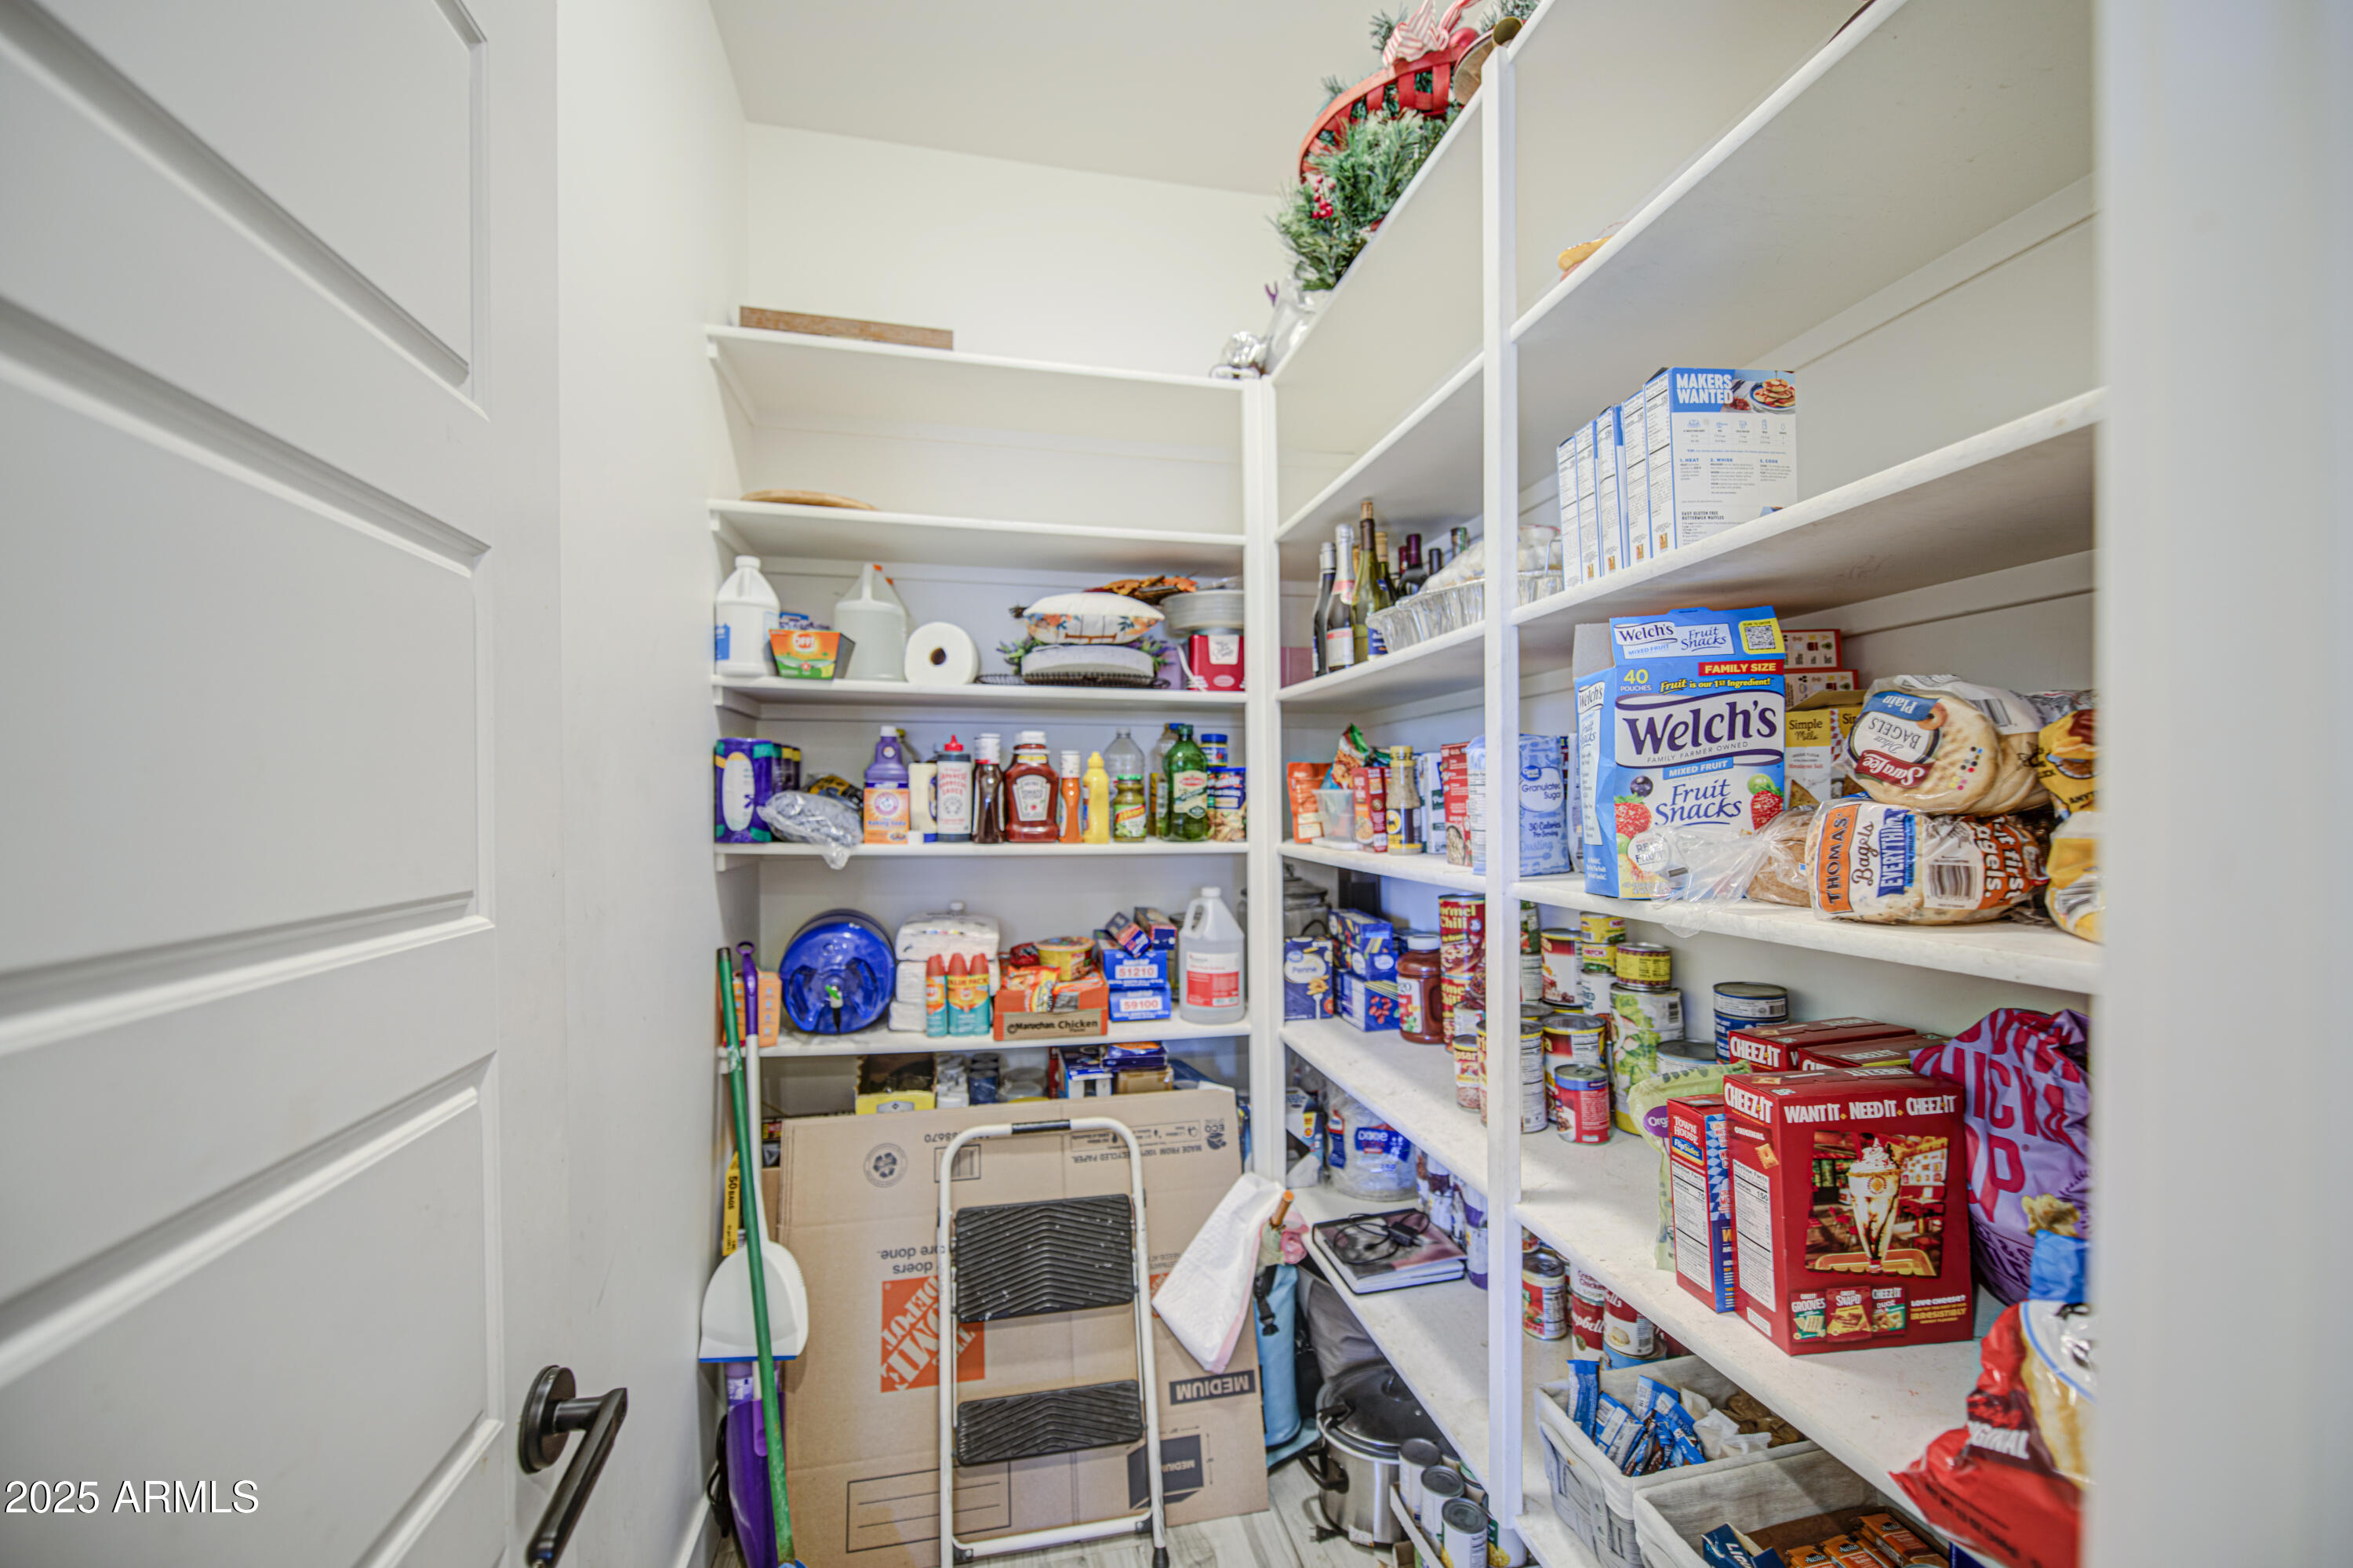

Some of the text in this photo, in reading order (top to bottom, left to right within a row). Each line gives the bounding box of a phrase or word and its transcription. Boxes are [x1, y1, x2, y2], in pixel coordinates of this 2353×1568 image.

[1676, 373, 1733, 389] MAKERS
[1677, 389, 1733, 405] WANTED
[1618, 624, 1674, 642] Welch's
[1688, 628, 1719, 640] Fruit
[1681, 634, 1726, 651] Snacks
[1705, 663, 1776, 673] FAMILY SIZE
[1624, 670, 1649, 684] 40
[1660, 678, 1688, 694] Fruit
[1727, 678, 1771, 689] Ingredient!
[1578, 683, 1603, 708] Welch's
[1882, 695, 1918, 714] Plain
[1623, 700, 1777, 755] Welch's
[1789, 720, 1823, 730] Simple
[1795, 731, 1819, 740] Mills
[1868, 717, 1921, 750] BAGELS
[1647, 742, 1747, 763] FAMILY FARMER OWNED
[1669, 760, 1727, 777] MIXED FRUIT
[1862, 754, 1925, 785] Sara Lee
[1671, 778, 1731, 806] Fruit
[1655, 797, 1742, 825] Snacks
[1851, 820, 1874, 886] Bagels
[1118, 966, 1155, 977] 51210
[1293, 965, 1318, 973] Penne
[1124, 999, 1158, 1010] 59100
[1058, 1020, 1098, 1030] Chicken
[1784, 1104, 1825, 1123] WANT
[1850, 1101, 1885, 1119] NEED
[1673, 1116, 1697, 1134] TOWN
[1674, 1126, 1699, 1144] HOUSE
[1734, 1126, 1765, 1141] ORIGINAL
[1757, 1191, 1769, 1202] 150
[878, 1250, 916, 1260] done.
[893, 1262, 933, 1275] doers
[1791, 1298, 1826, 1312] GROOVES
[1176, 1375, 1250, 1401] MEDIUM
[1882, 1523, 1902, 1532] Austin
[1805, 1555, 1826, 1563] Austin
